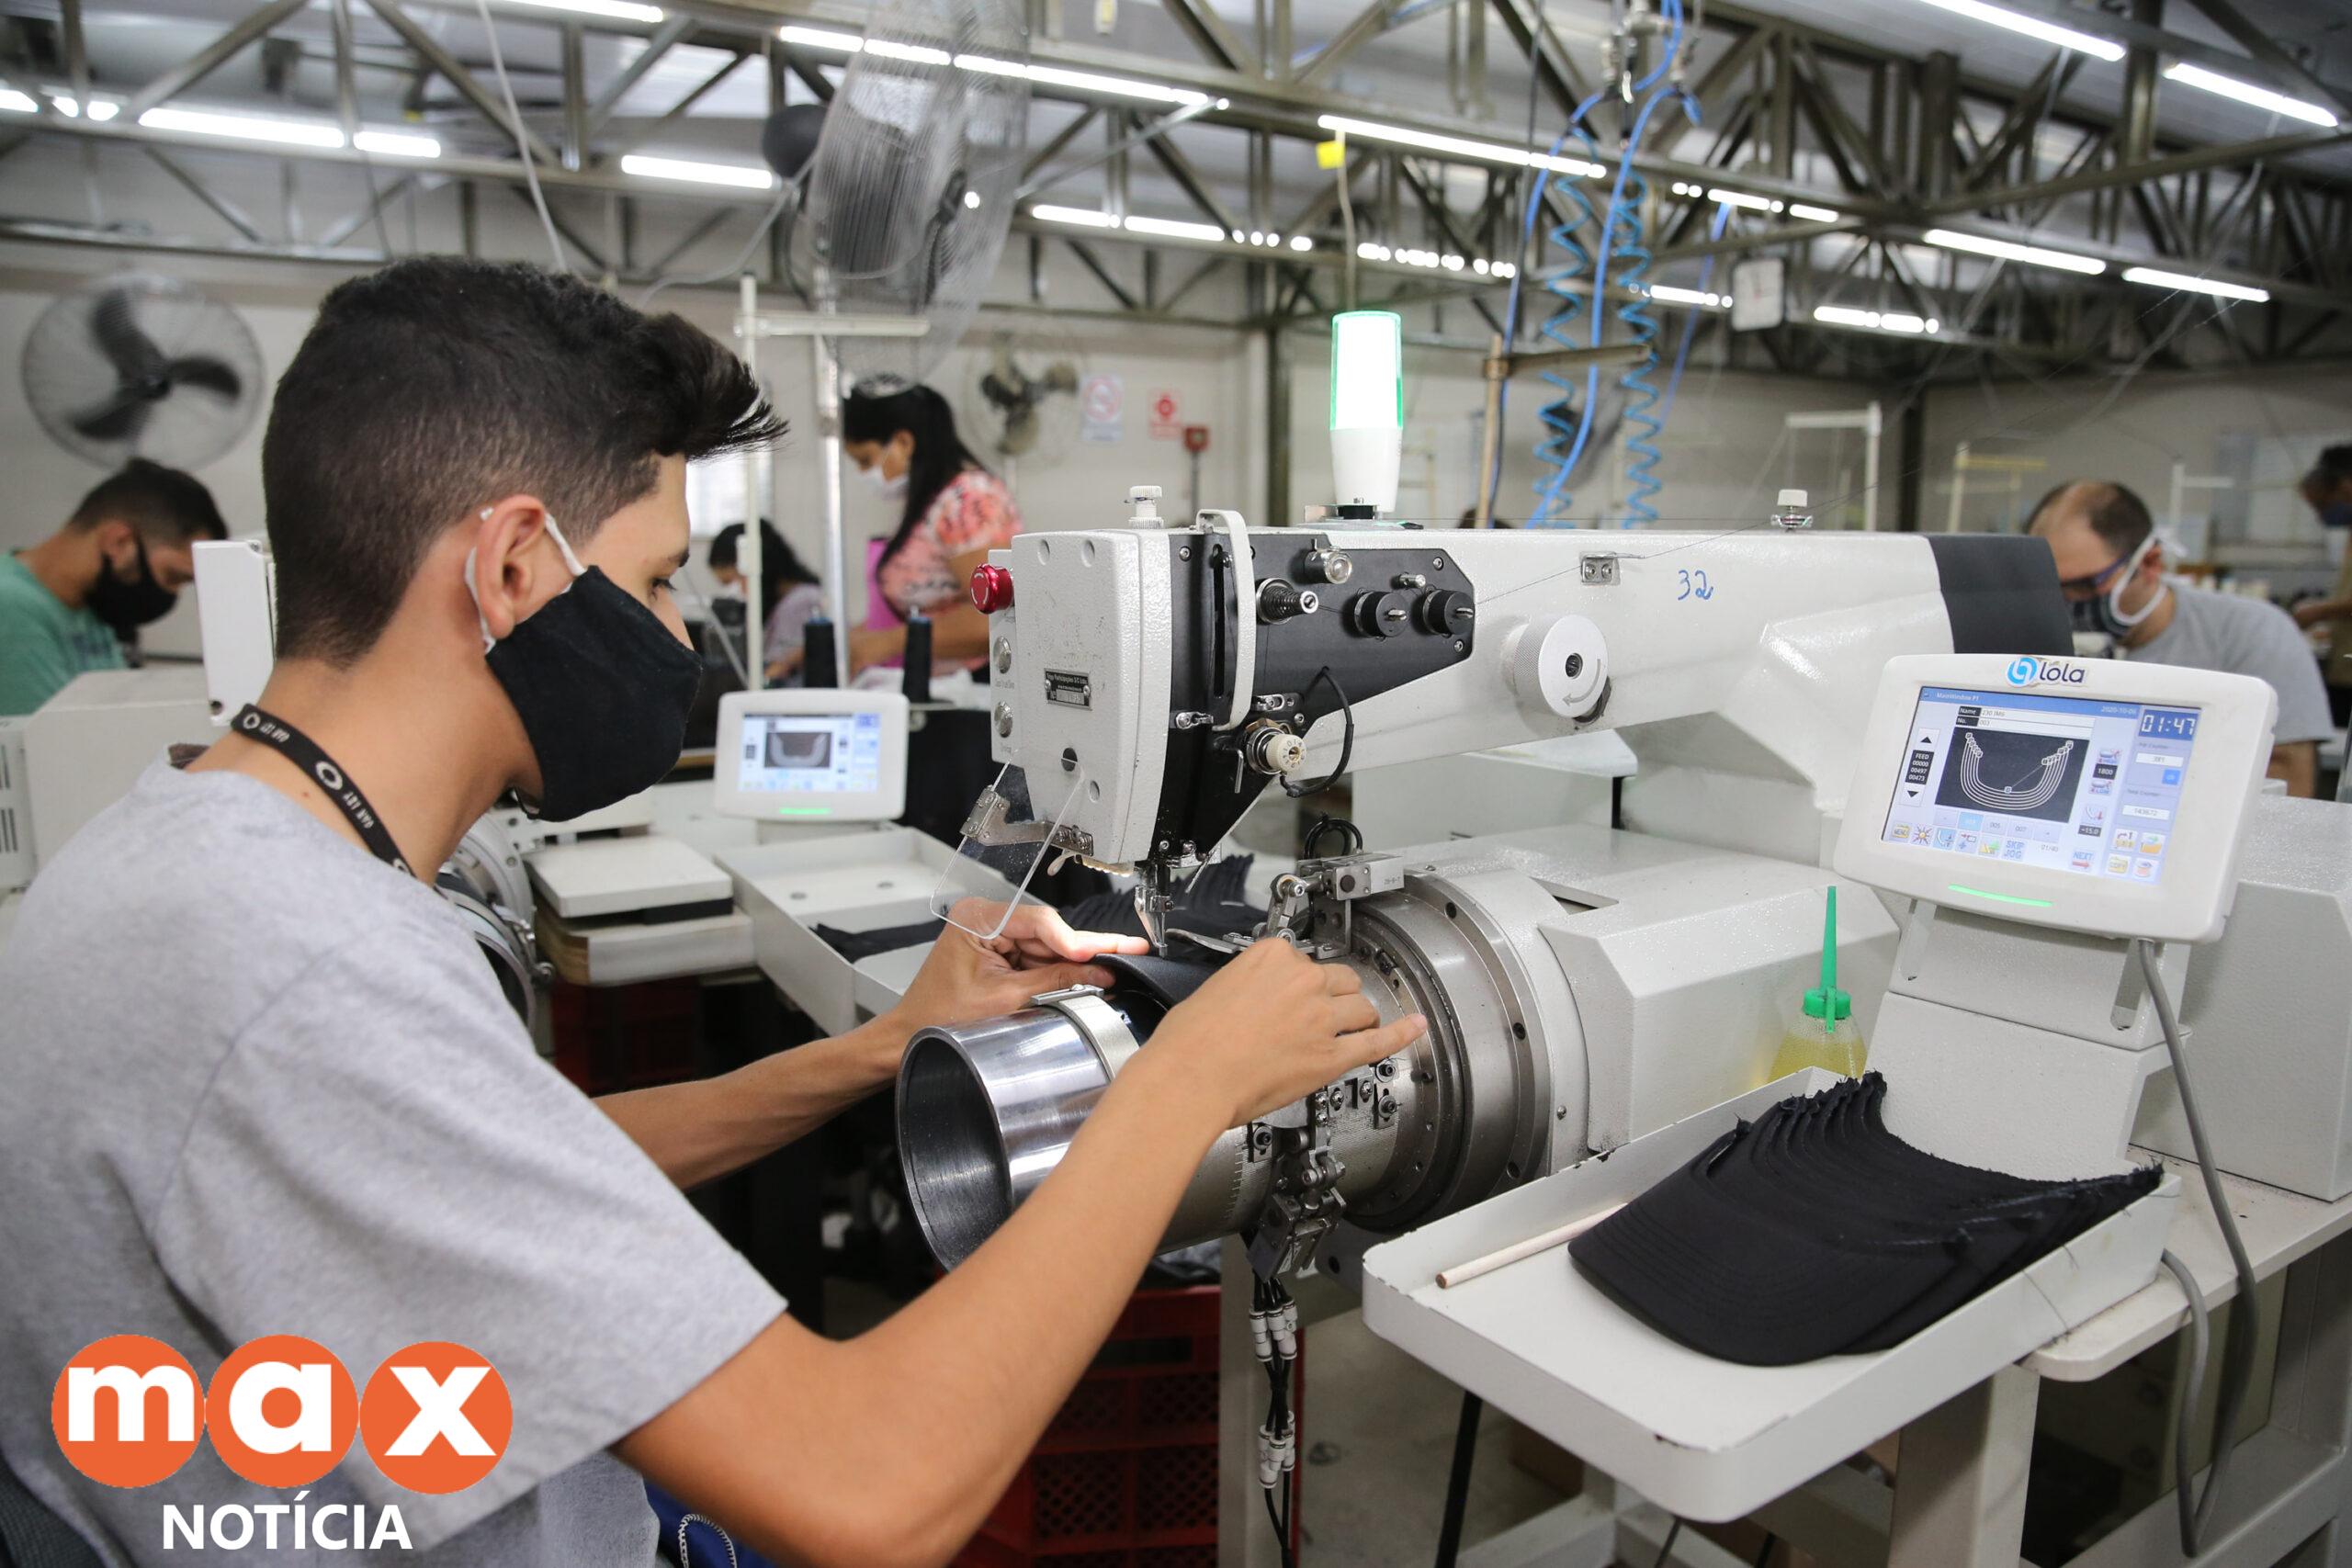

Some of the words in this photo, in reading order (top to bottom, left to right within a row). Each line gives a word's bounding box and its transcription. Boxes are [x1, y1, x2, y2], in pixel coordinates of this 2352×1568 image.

[1678, 570, 1714, 601] 32
[2039, 661, 2086, 683] lola
[2141, 715, 2196, 736] 01:47
[2006, 840, 2025, 849] SKIP
[2003, 850, 2022, 859] JOG
[2073, 852, 2094, 861] NEXT
